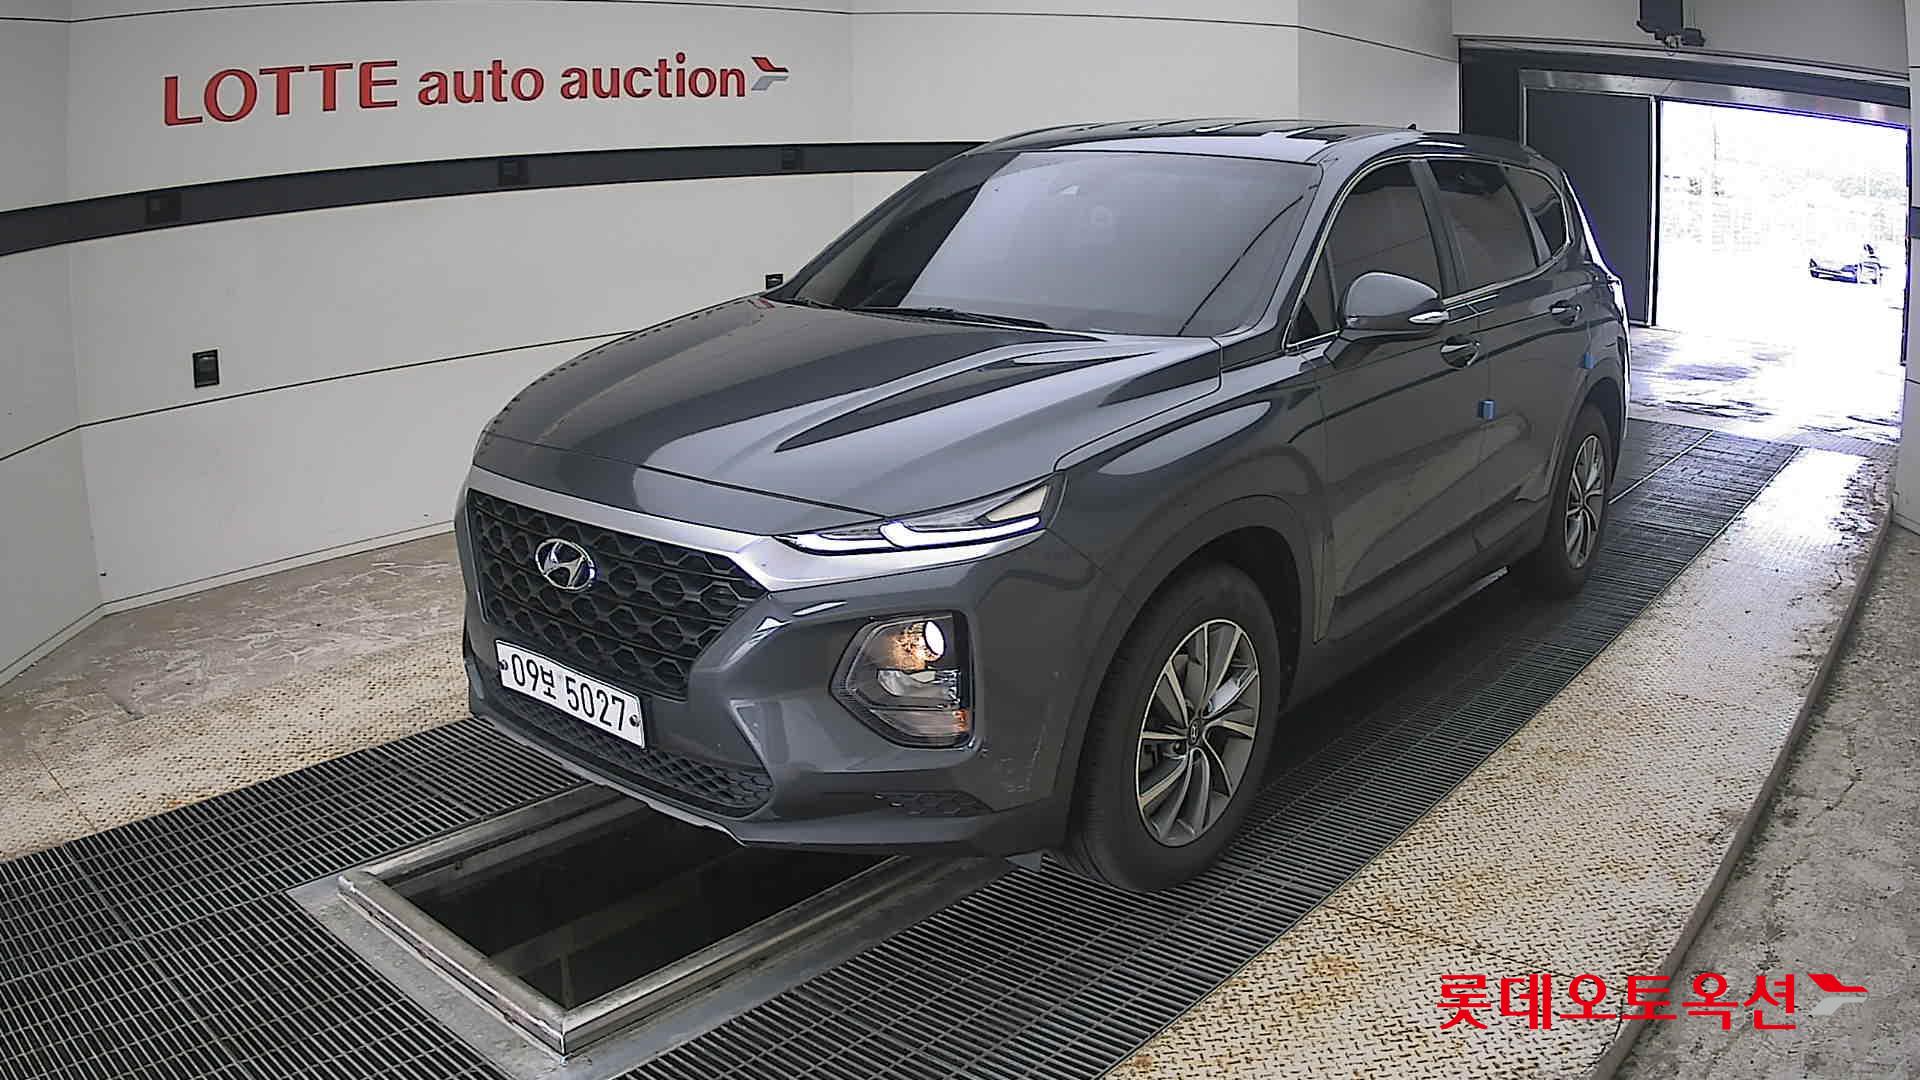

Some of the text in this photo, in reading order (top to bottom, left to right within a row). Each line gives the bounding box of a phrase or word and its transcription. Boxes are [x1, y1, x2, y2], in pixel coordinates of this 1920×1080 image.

[163, 52, 747, 127] LOTTE auto auction
[511, 653, 625, 731] 09보 5027
